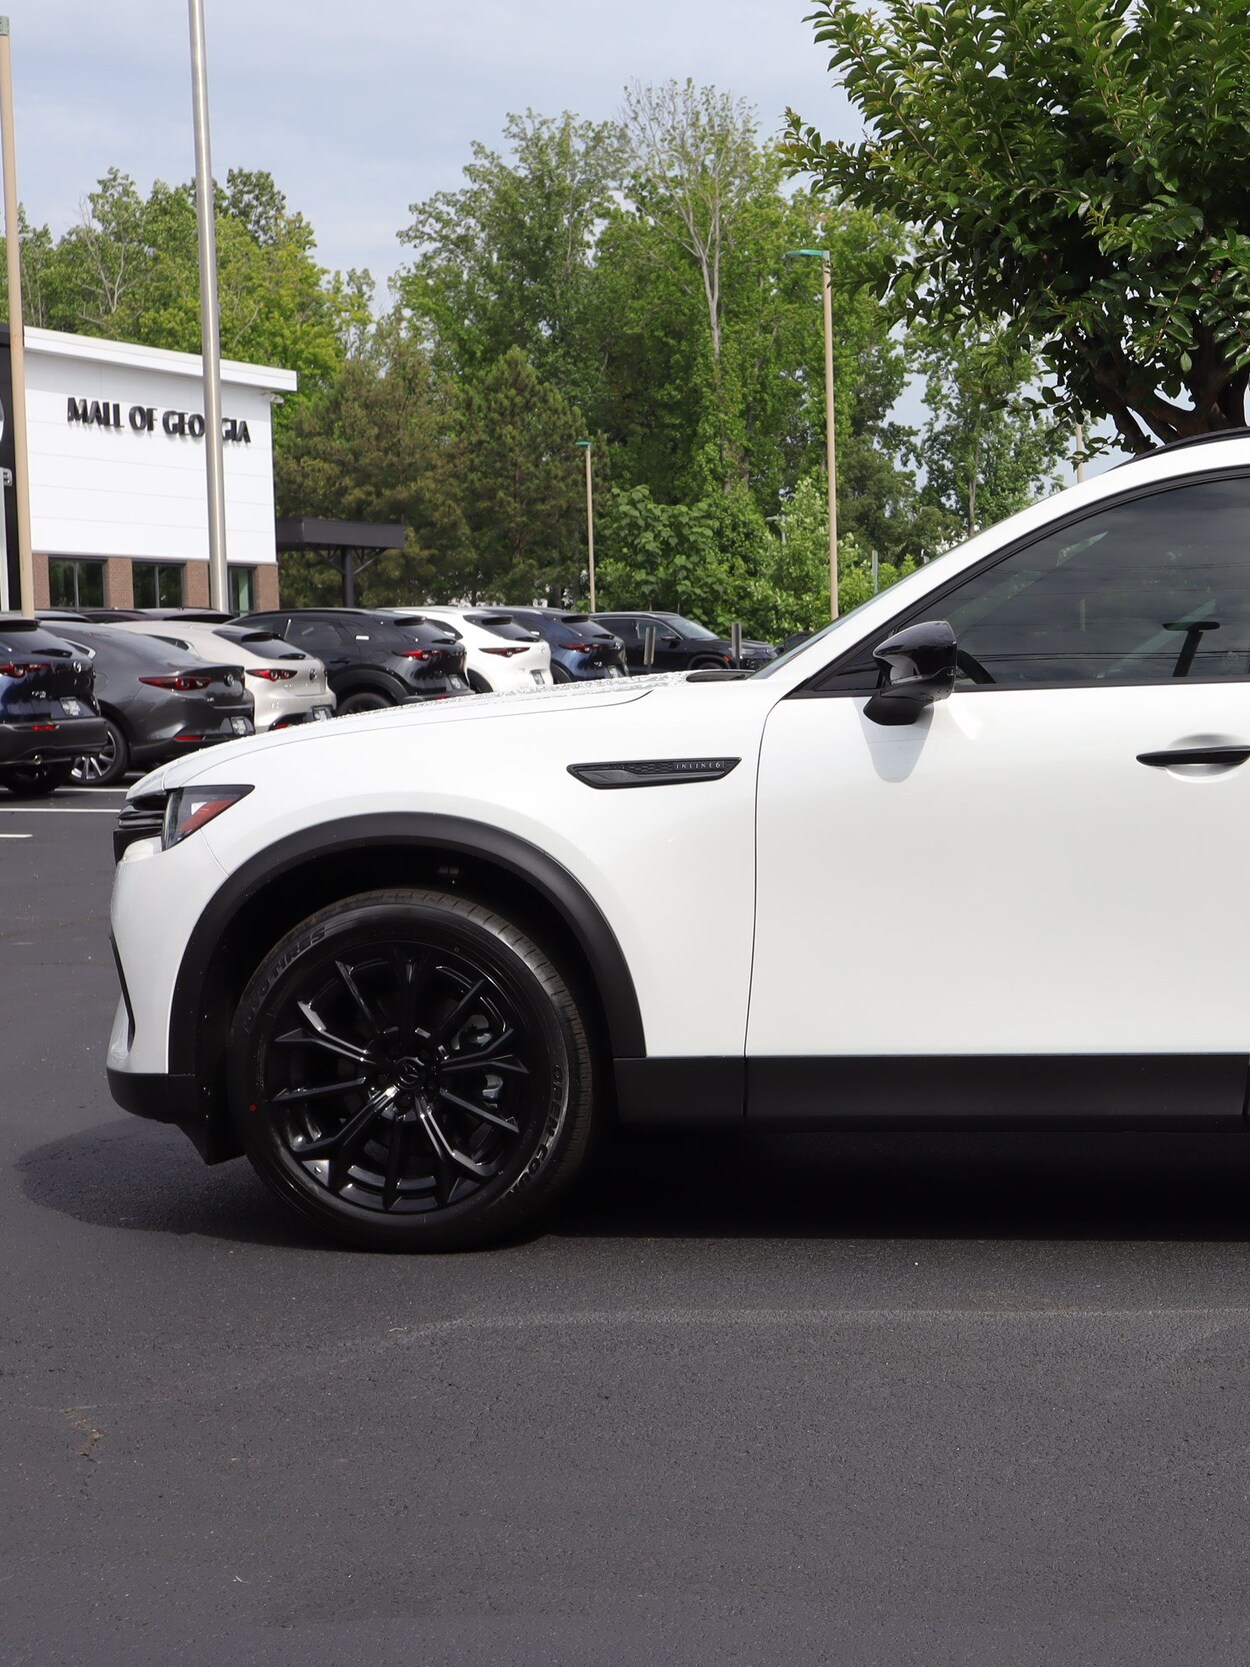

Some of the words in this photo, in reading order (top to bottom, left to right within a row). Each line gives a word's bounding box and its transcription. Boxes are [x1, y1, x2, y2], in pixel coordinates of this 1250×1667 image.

[67, 397, 124, 428] MALL
[129, 406, 157, 431] OF
[162, 410, 251, 443] GEOGIA
